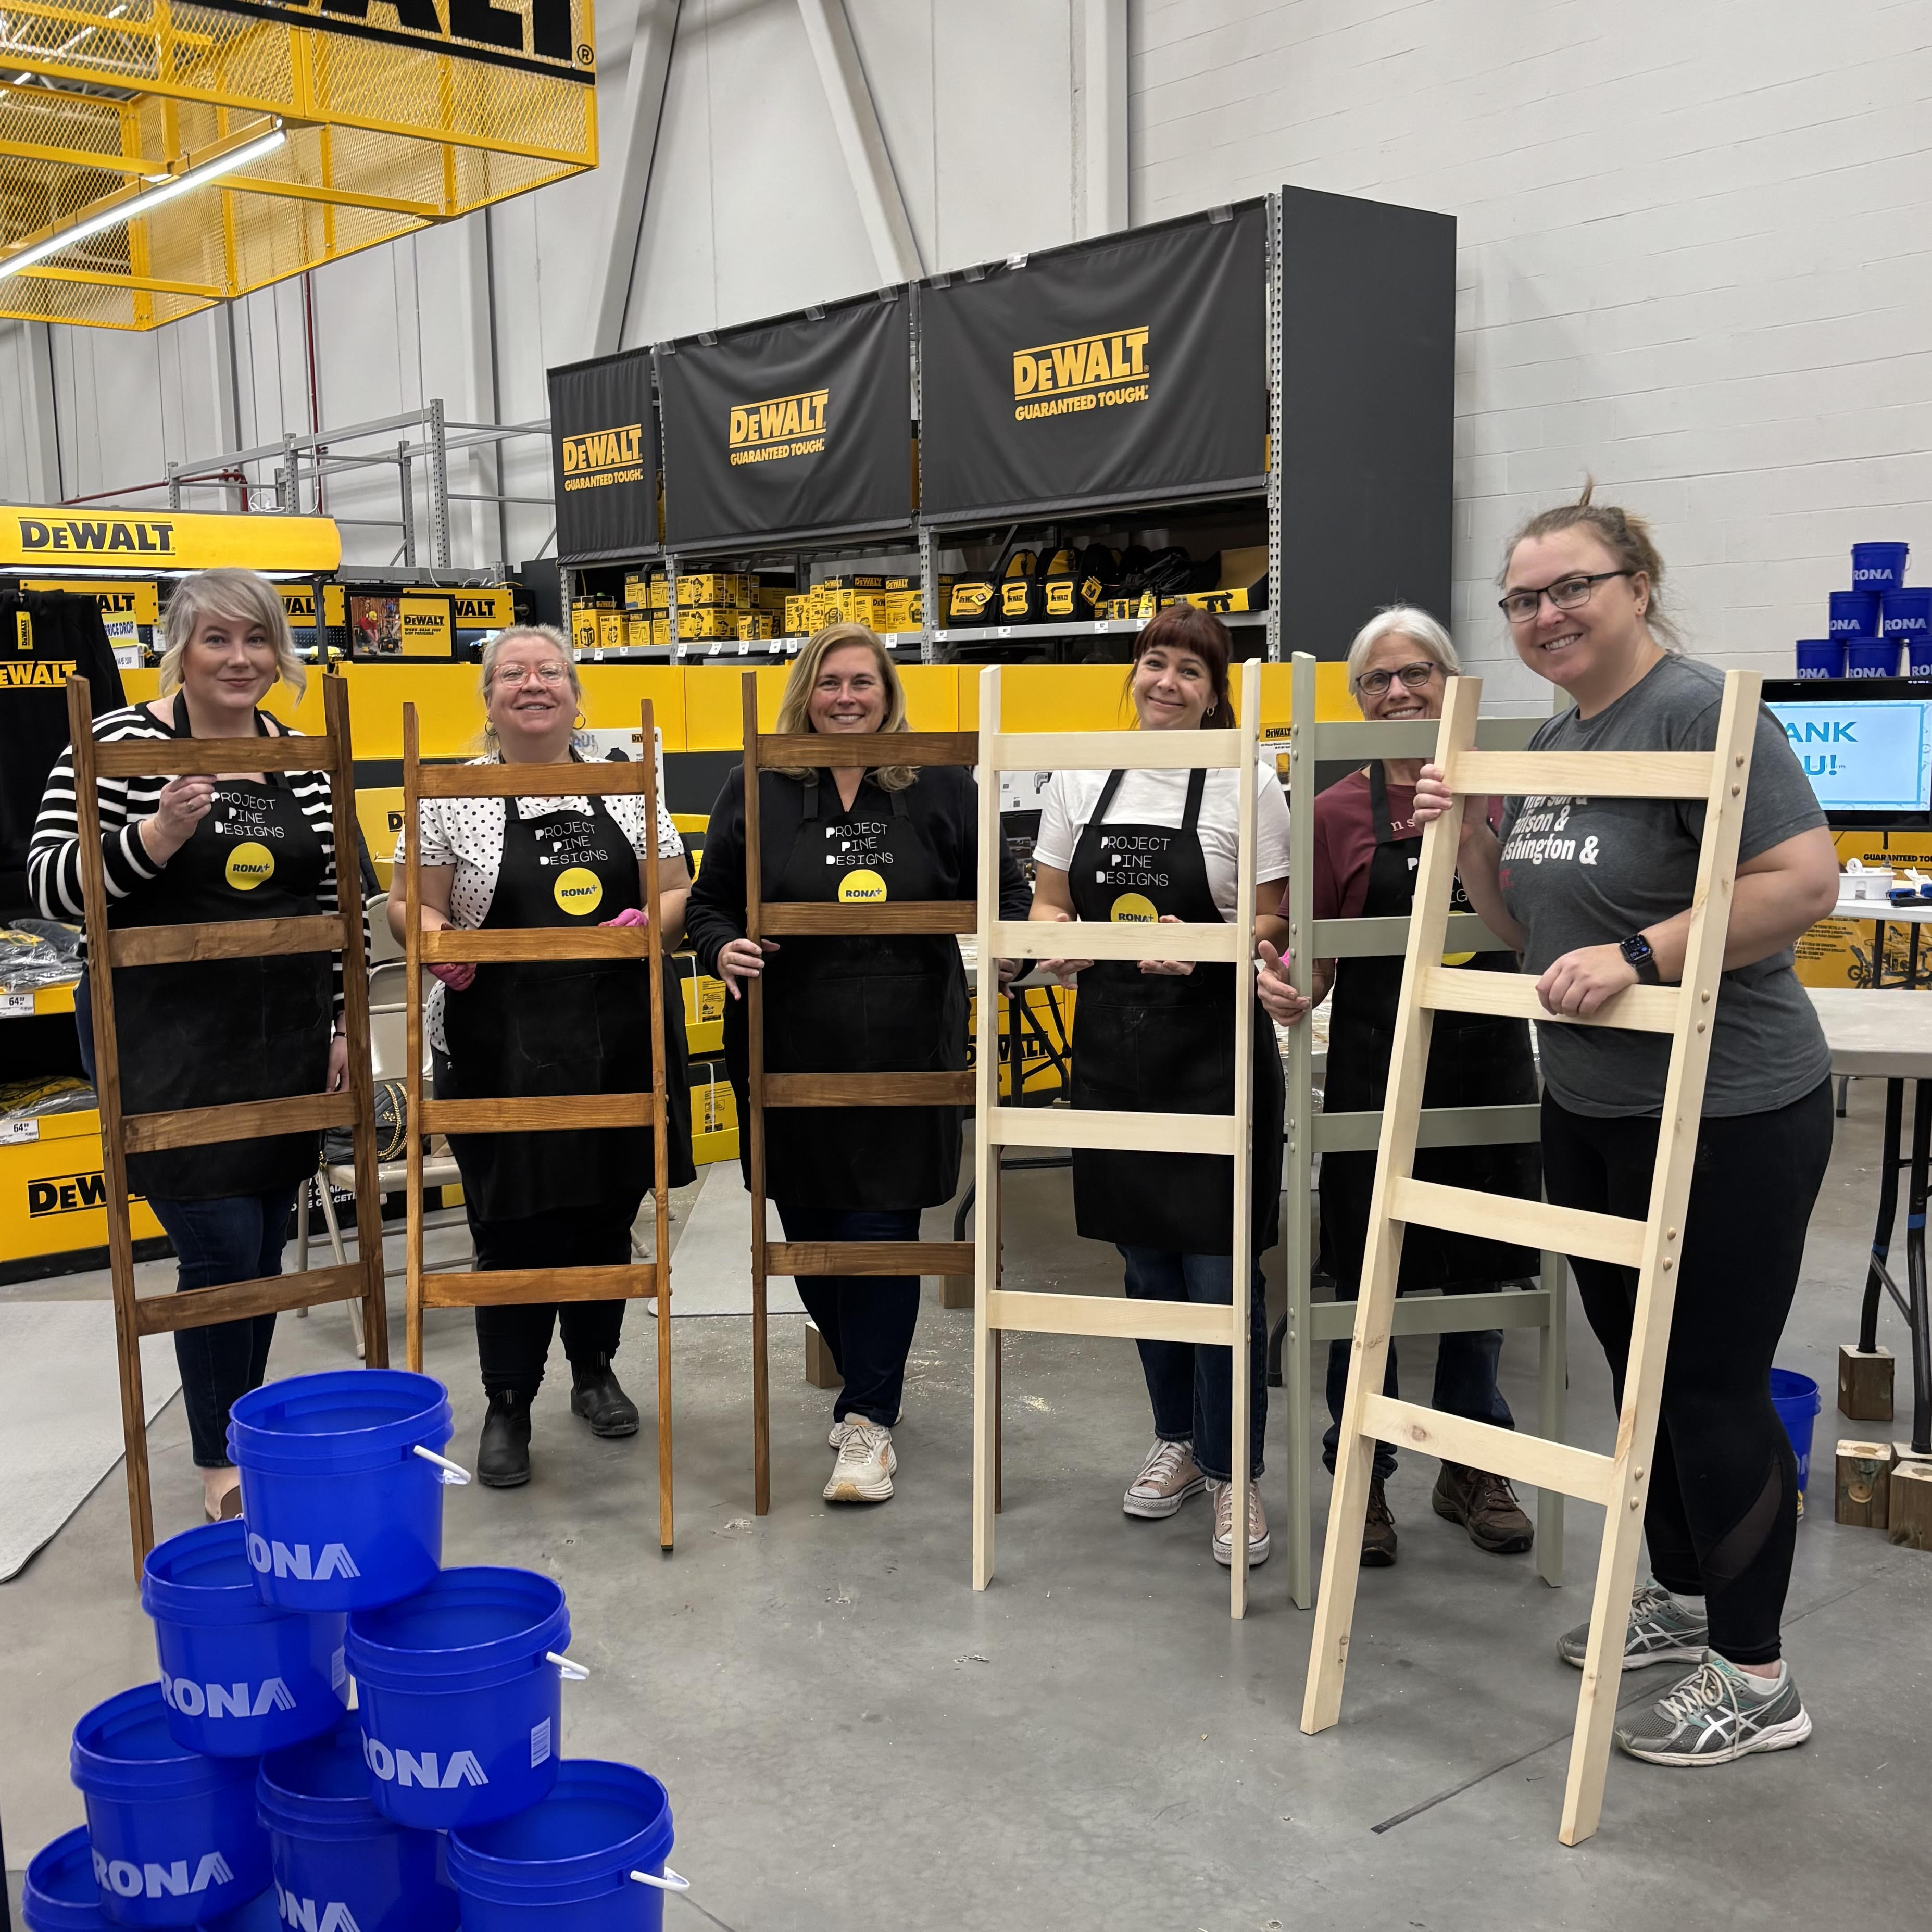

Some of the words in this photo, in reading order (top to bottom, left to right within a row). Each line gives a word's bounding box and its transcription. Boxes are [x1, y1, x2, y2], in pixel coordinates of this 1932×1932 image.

[1015, 394, 1097, 421] GUARANTEED
[730, 445, 790, 466] GUARANTEED
[564, 473, 613, 491] GUARANTEED
[97, 595, 135, 611] ALT
[1830, 619, 1861, 630] ONA
[1884, 618, 1927, 631] RONA
[0, 664, 77, 685] EWALT
[1797, 668, 1829, 679] ONA
[1784, 721, 1859, 743] ANK
[1804, 754, 1837, 776] U!
[210, 792, 276, 810] PROJECT
[229, 807, 266, 824] PINE
[215, 821, 285, 838] DESIGNS
[535, 821, 595, 841] PROJECT
[826, 822, 888, 838] PROJECT
[553, 835, 591, 853] PINE
[842, 837, 878, 852] PINE
[1101, 836, 1171, 851] PROJECT
[1501, 833, 1576, 865] ashington
[1579, 835, 1600, 865] &
[540, 849, 608, 865] DESIGNS
[826, 852, 894, 865] DESIGNS
[1111, 854, 1152, 868] PINE
[1096, 871, 1169, 887] DESIGNS
[28, 1175, 107, 1213] DEW
[245, 1524, 361, 1580] ONA
[160, 1670, 297, 1718] RONA
[92, 1847, 234, 1898] RONA
